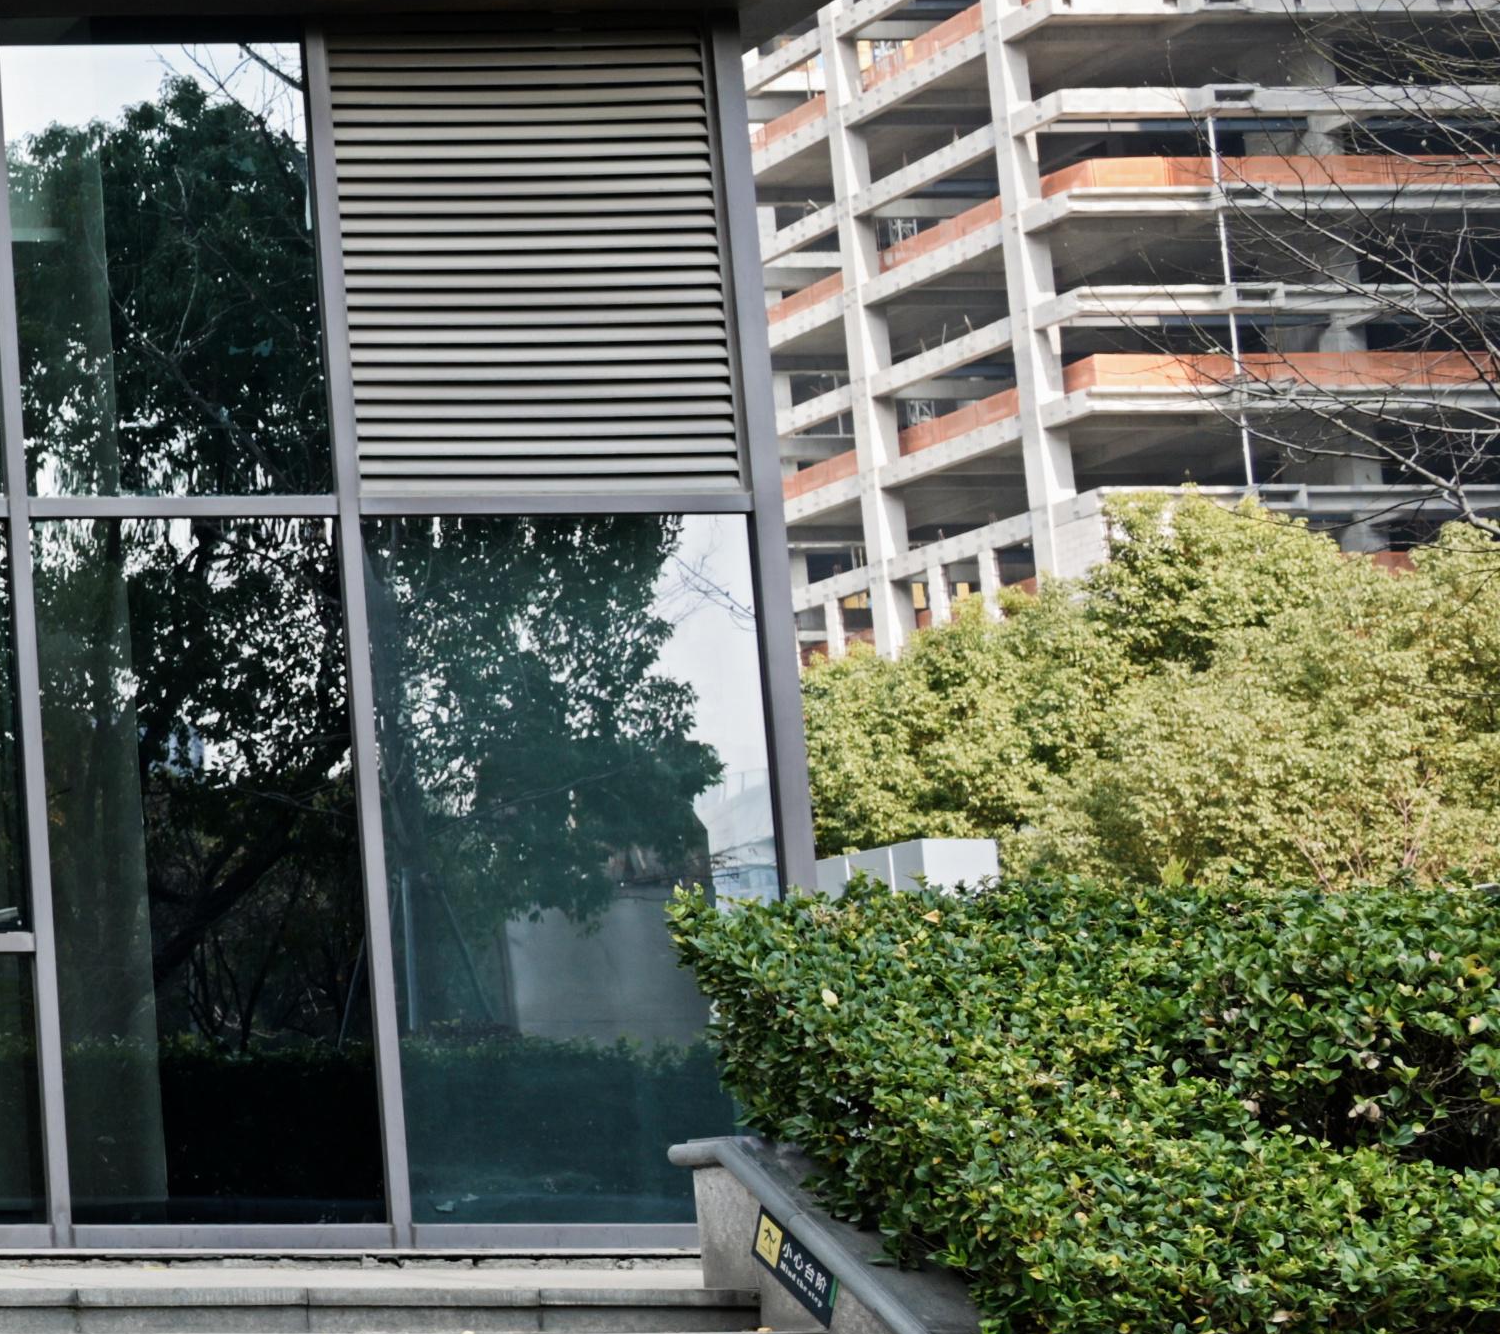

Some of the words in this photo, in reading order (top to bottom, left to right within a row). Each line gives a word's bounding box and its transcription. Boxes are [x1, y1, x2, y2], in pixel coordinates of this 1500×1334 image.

[780, 1260, 797, 1282] Mind
[796, 1277, 808, 1292] the
[807, 1290, 823, 1308] step
[782, 1243, 827, 1295] 小心台阶
